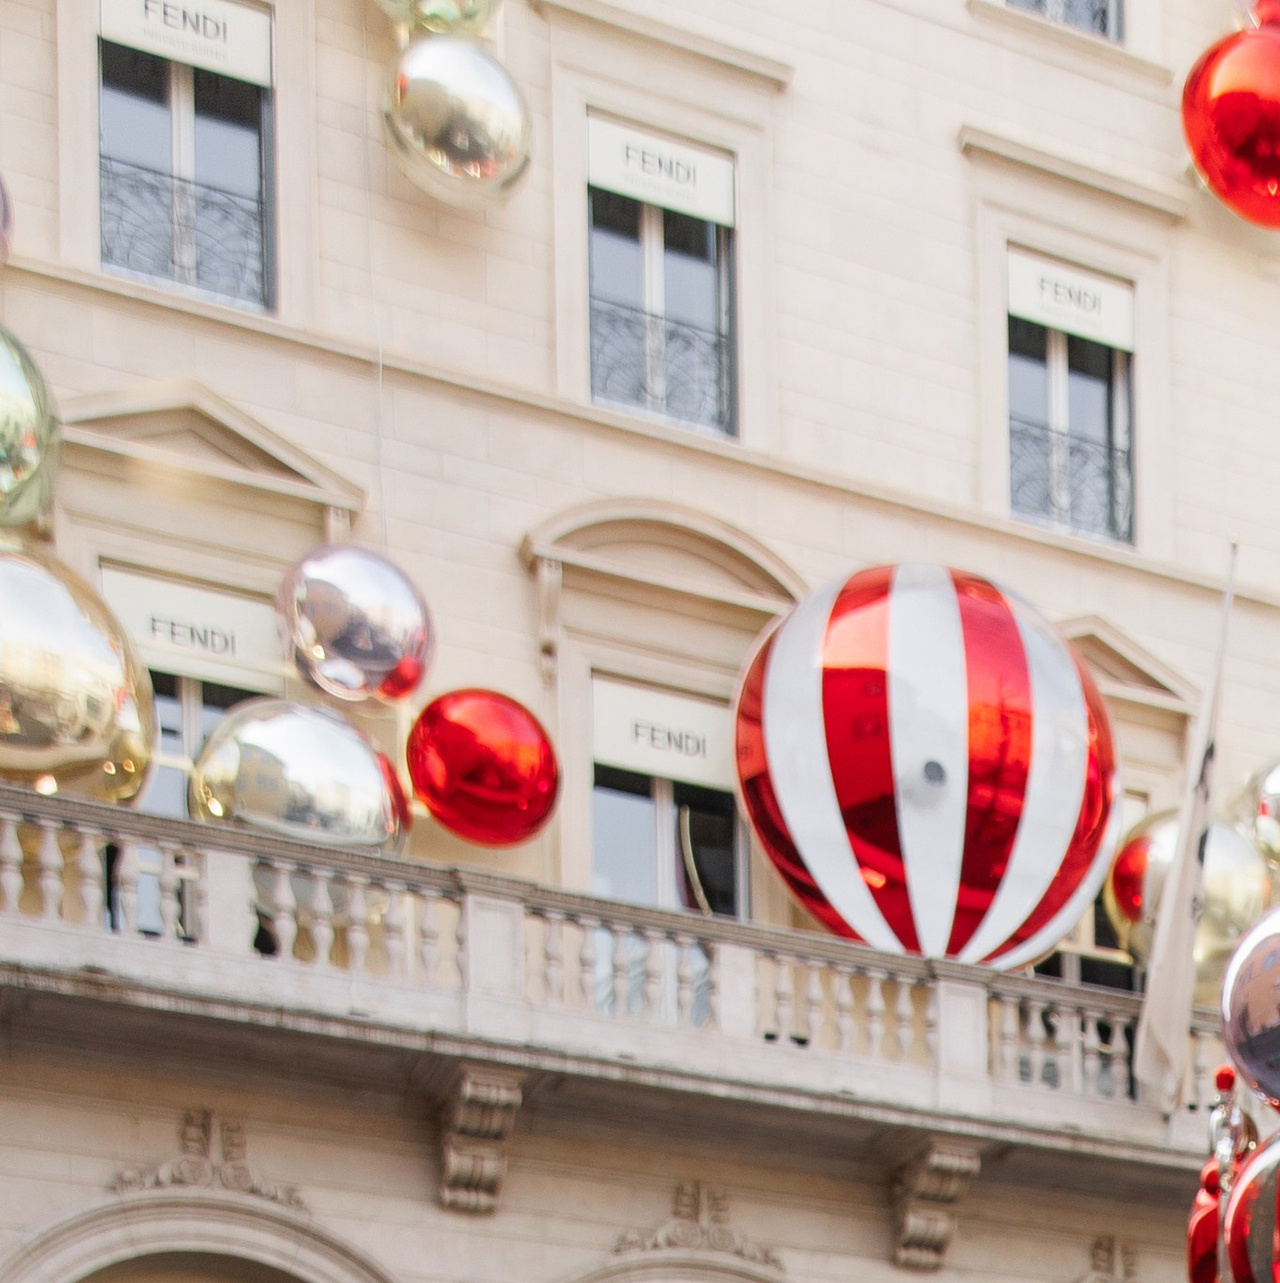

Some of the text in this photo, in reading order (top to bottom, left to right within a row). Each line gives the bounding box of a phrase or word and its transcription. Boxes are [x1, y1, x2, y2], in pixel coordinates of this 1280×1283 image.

[144, 0, 228, 43] FENDI
[625, 144, 697, 187] FENDI
[1040, 278, 1101, 315] FENDI
[151, 616, 236, 655] FENDI
[635, 723, 706, 758] FENDI
